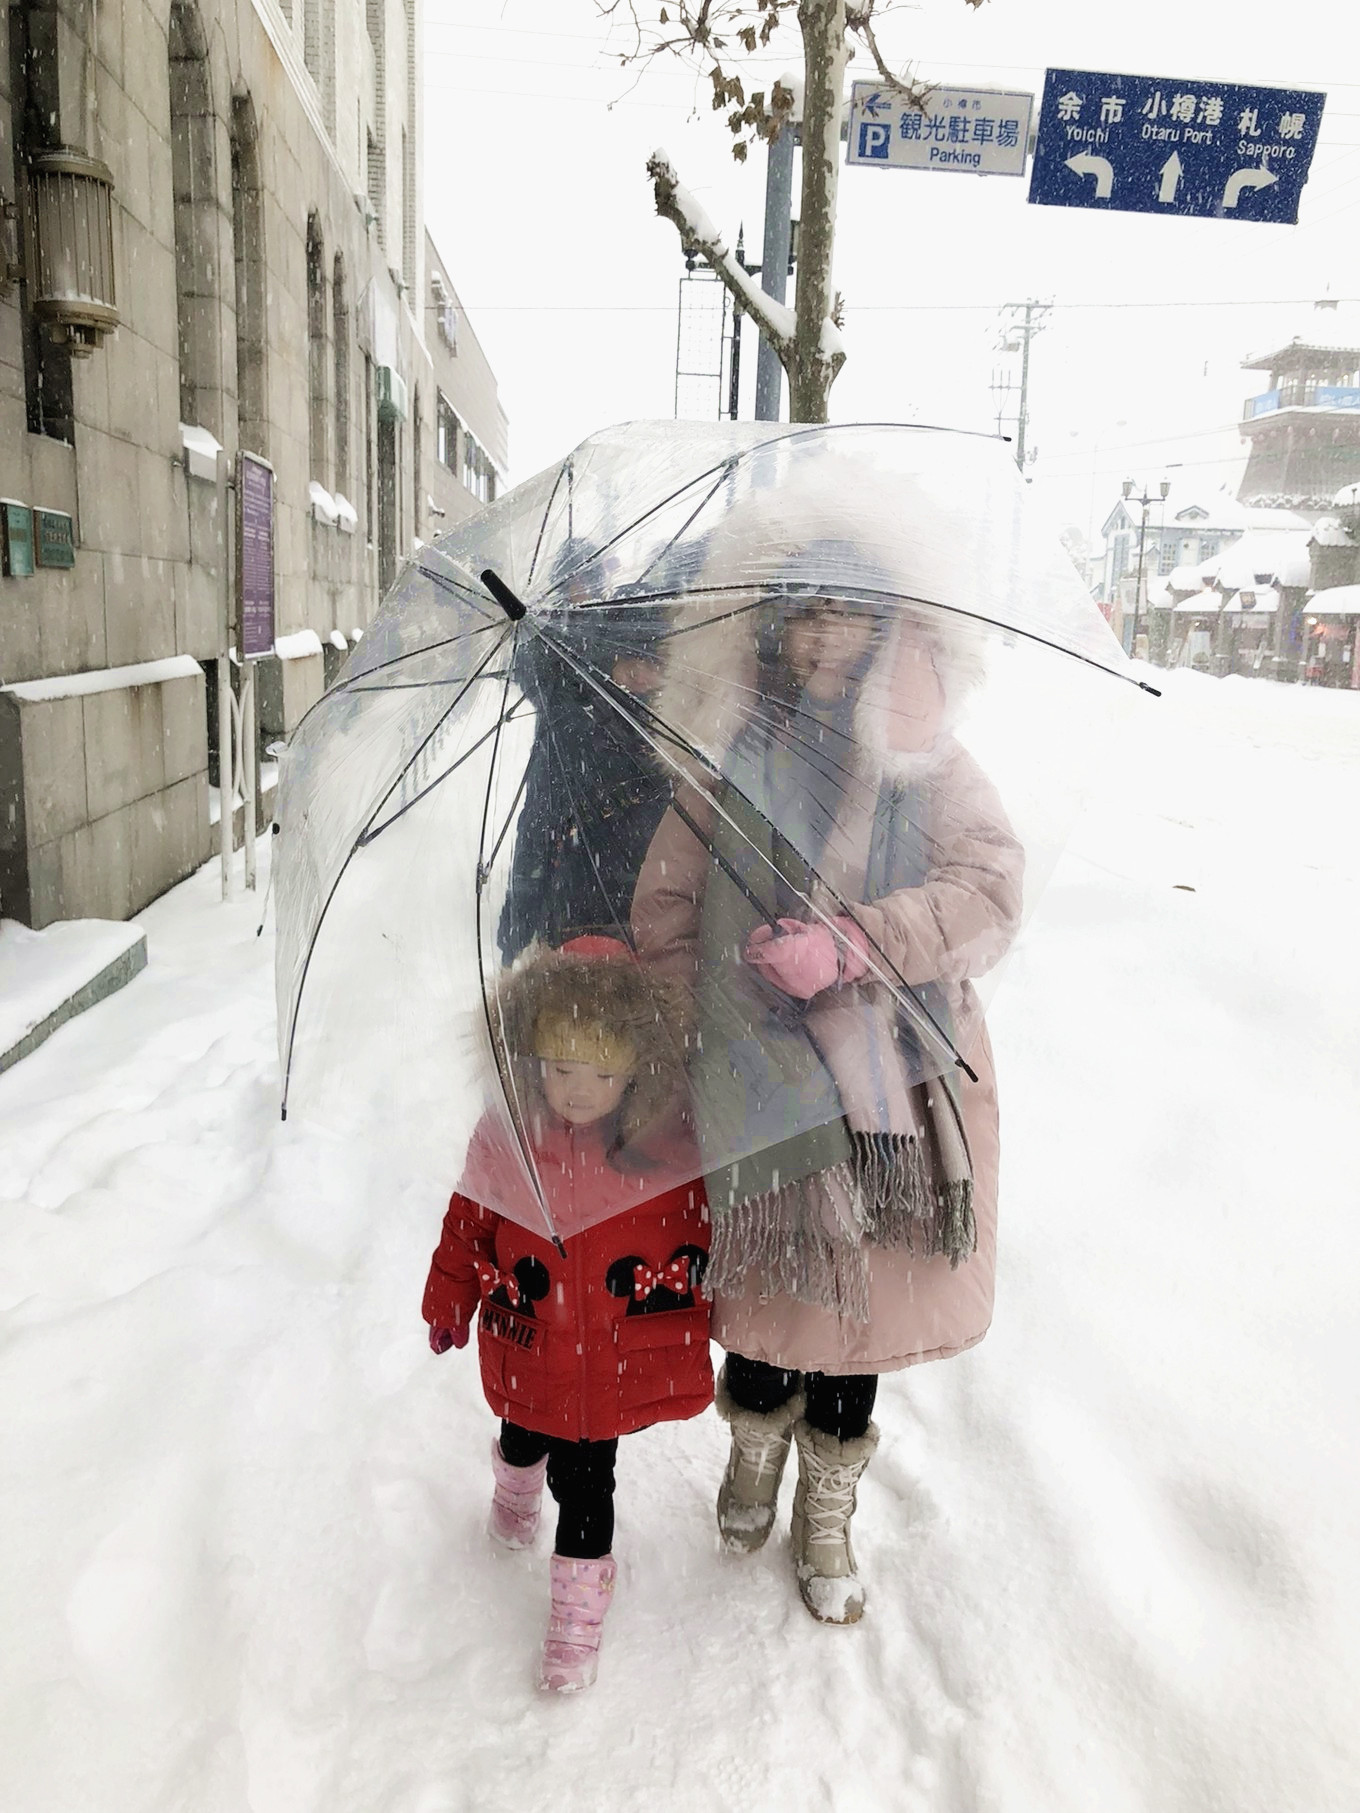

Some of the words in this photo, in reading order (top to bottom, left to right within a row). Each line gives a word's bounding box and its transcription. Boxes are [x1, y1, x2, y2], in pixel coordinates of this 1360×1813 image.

[943, 98, 982, 110] 小樽市
[1057, 91, 1126, 124] 余市
[1142, 91, 1224, 126] 小樽港
[899, 112, 1020, 148] 観光駐車場
[1066, 125, 1110, 143] Yoichi
[1141, 123, 1180, 142] Otaru
[1183, 128, 1213, 145] Port
[1238, 107, 1306, 140] 札幌
[865, 125, 887, 156] P
[1236, 139, 1296, 159] Sapporo
[929, 147, 982, 168] Parking
[483, 1308, 537, 1350] MINNIE
